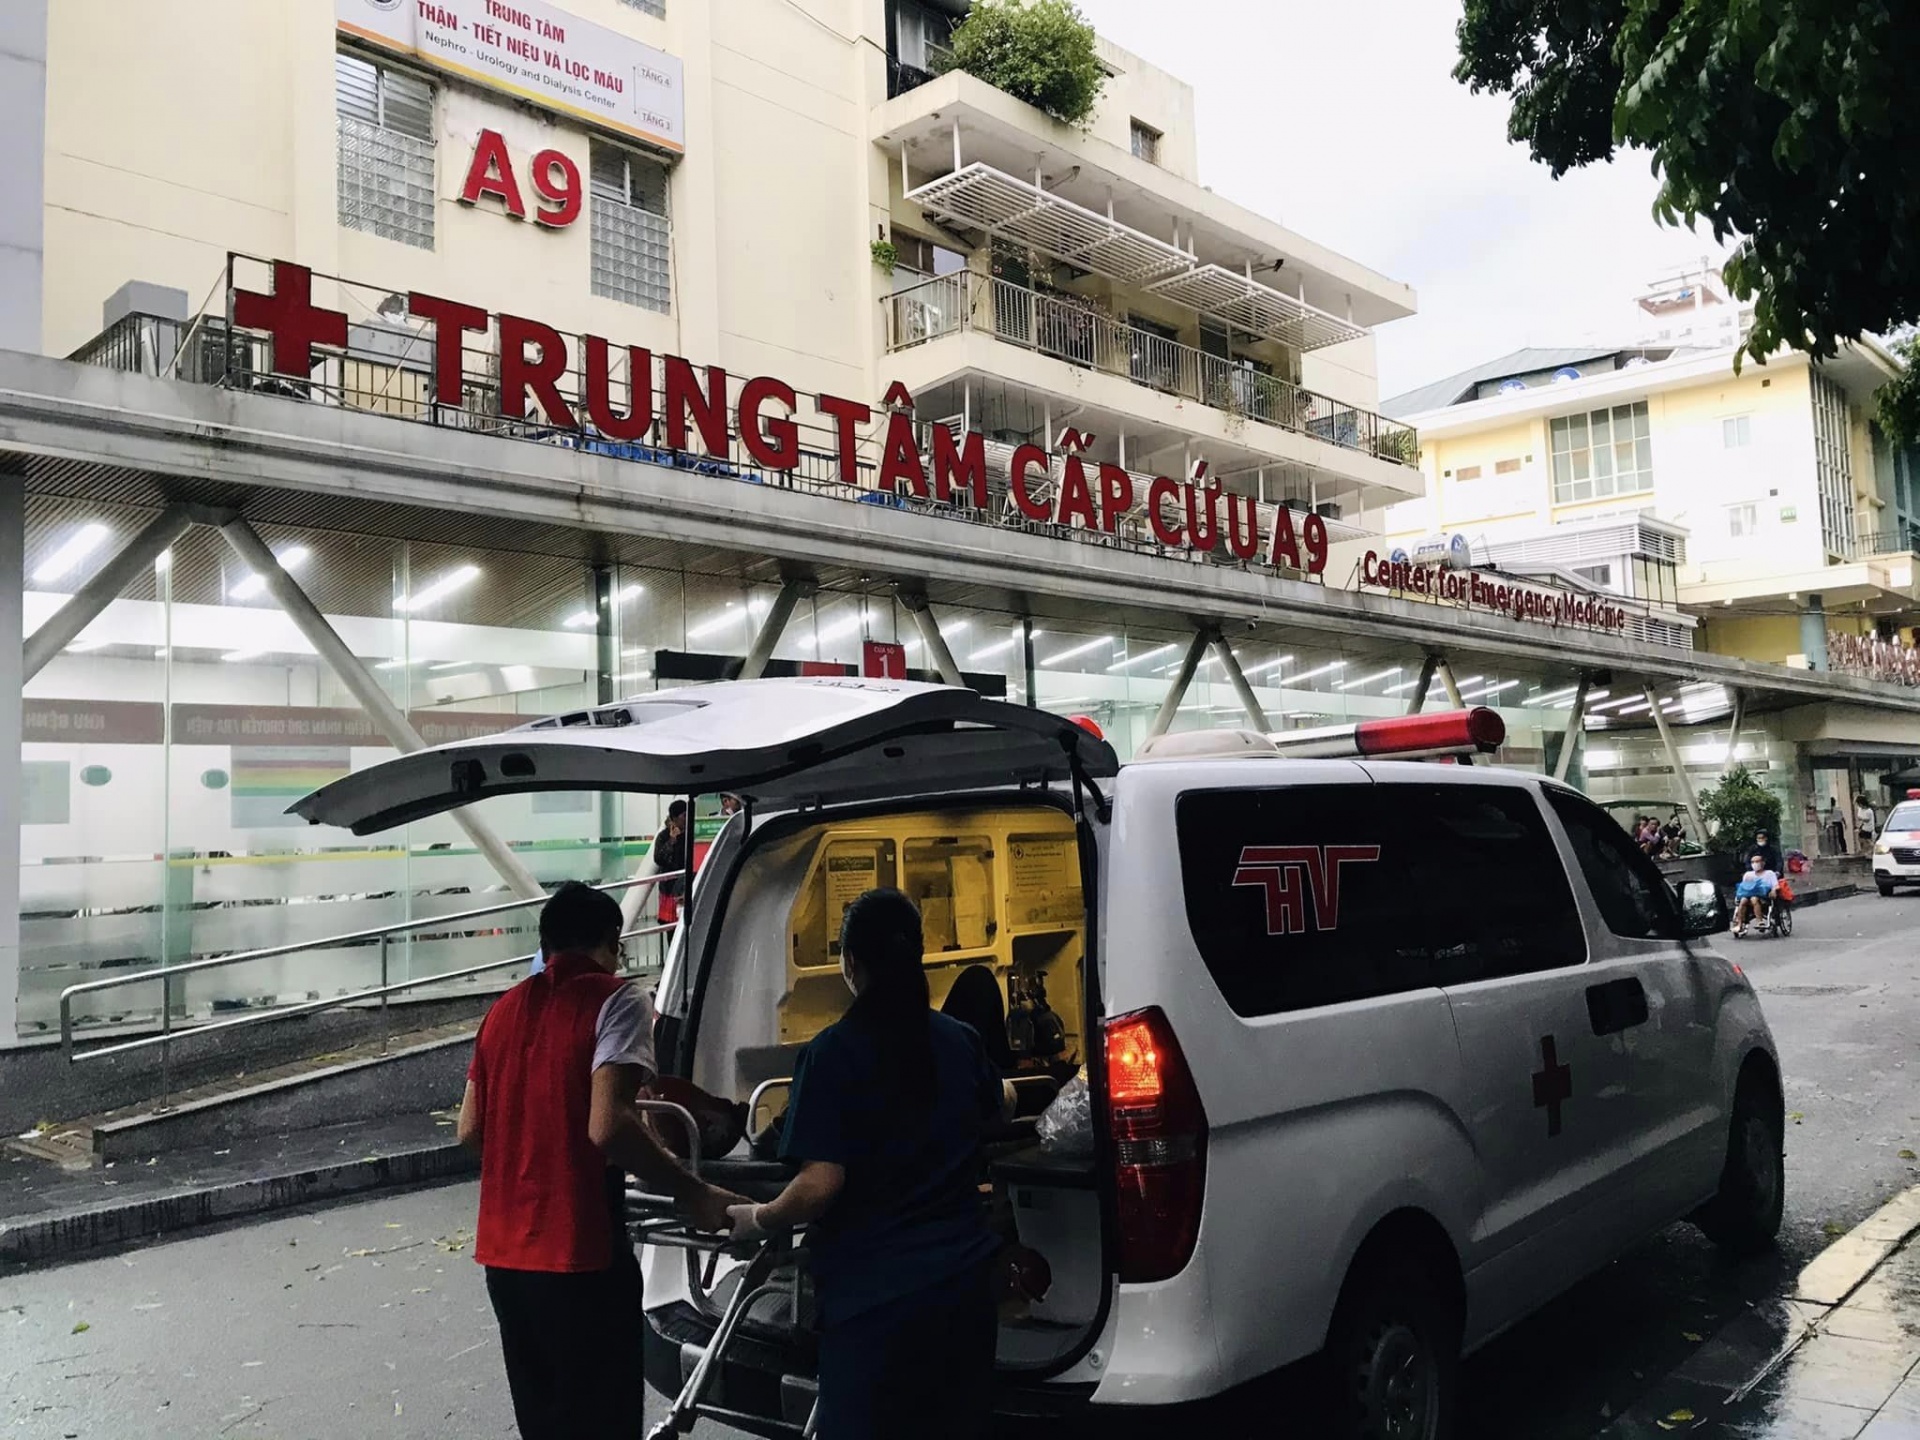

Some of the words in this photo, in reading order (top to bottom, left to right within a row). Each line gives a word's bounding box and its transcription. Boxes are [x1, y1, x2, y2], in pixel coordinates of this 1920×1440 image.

[417, 0, 458, 30] THẬN
[472, 22, 502, 47] TIẾT
[507, 36, 540, 62] NIỆU
[543, 48, 561, 71] VÀ
[565, 58, 590, 81] LỌC
[594, 67, 623, 94] MÁU
[486, 0, 531, 31] TRUNG
[536, 19, 565, 44] TÂM
[425, 30, 467, 54] Nephro
[477, 50, 518, 75] Urology
[521, 66, 541, 82] and
[543, 75, 582, 97] Dialysis
[585, 89, 616, 109] Center
[457, 128, 583, 228] A9
[408, 291, 799, 471] TRUNG
[814, 380, 988, 509] TÂM
[1006, 426, 1133, 535] CẤP
[1148, 461, 1259, 560] CỨU
[1270, 505, 1328, 575] A9
[1364, 550, 1434, 594] Center
[1437, 566, 1468, 600] for
[1471, 572, 1561, 628] Emergency
[1563, 592, 1625, 629] Medicine
[879, 654, 890, 679] 1
